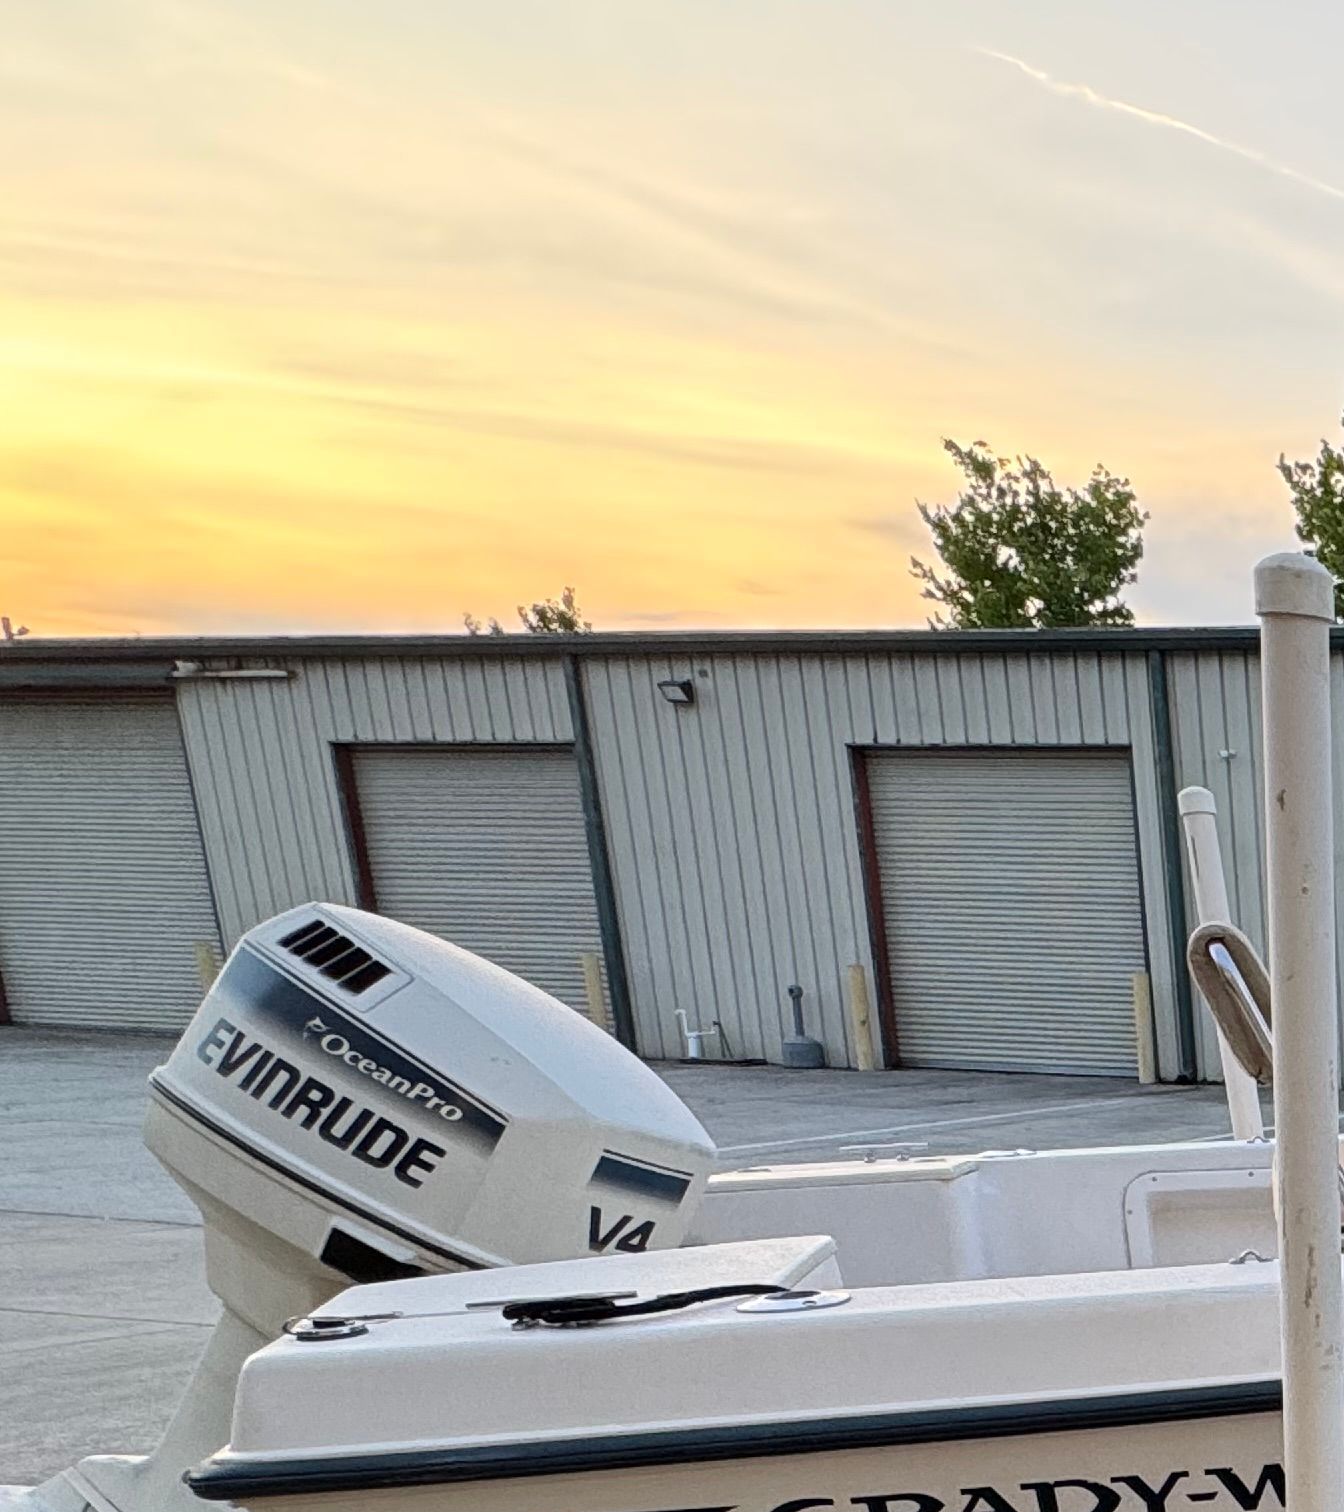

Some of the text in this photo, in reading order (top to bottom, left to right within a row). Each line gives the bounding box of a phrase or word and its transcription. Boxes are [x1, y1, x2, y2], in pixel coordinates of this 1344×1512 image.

[196, 1018, 447, 1189] EVINRUDE
[321, 1032, 463, 1123] OceanPro
[588, 1205, 655, 1253] V4
